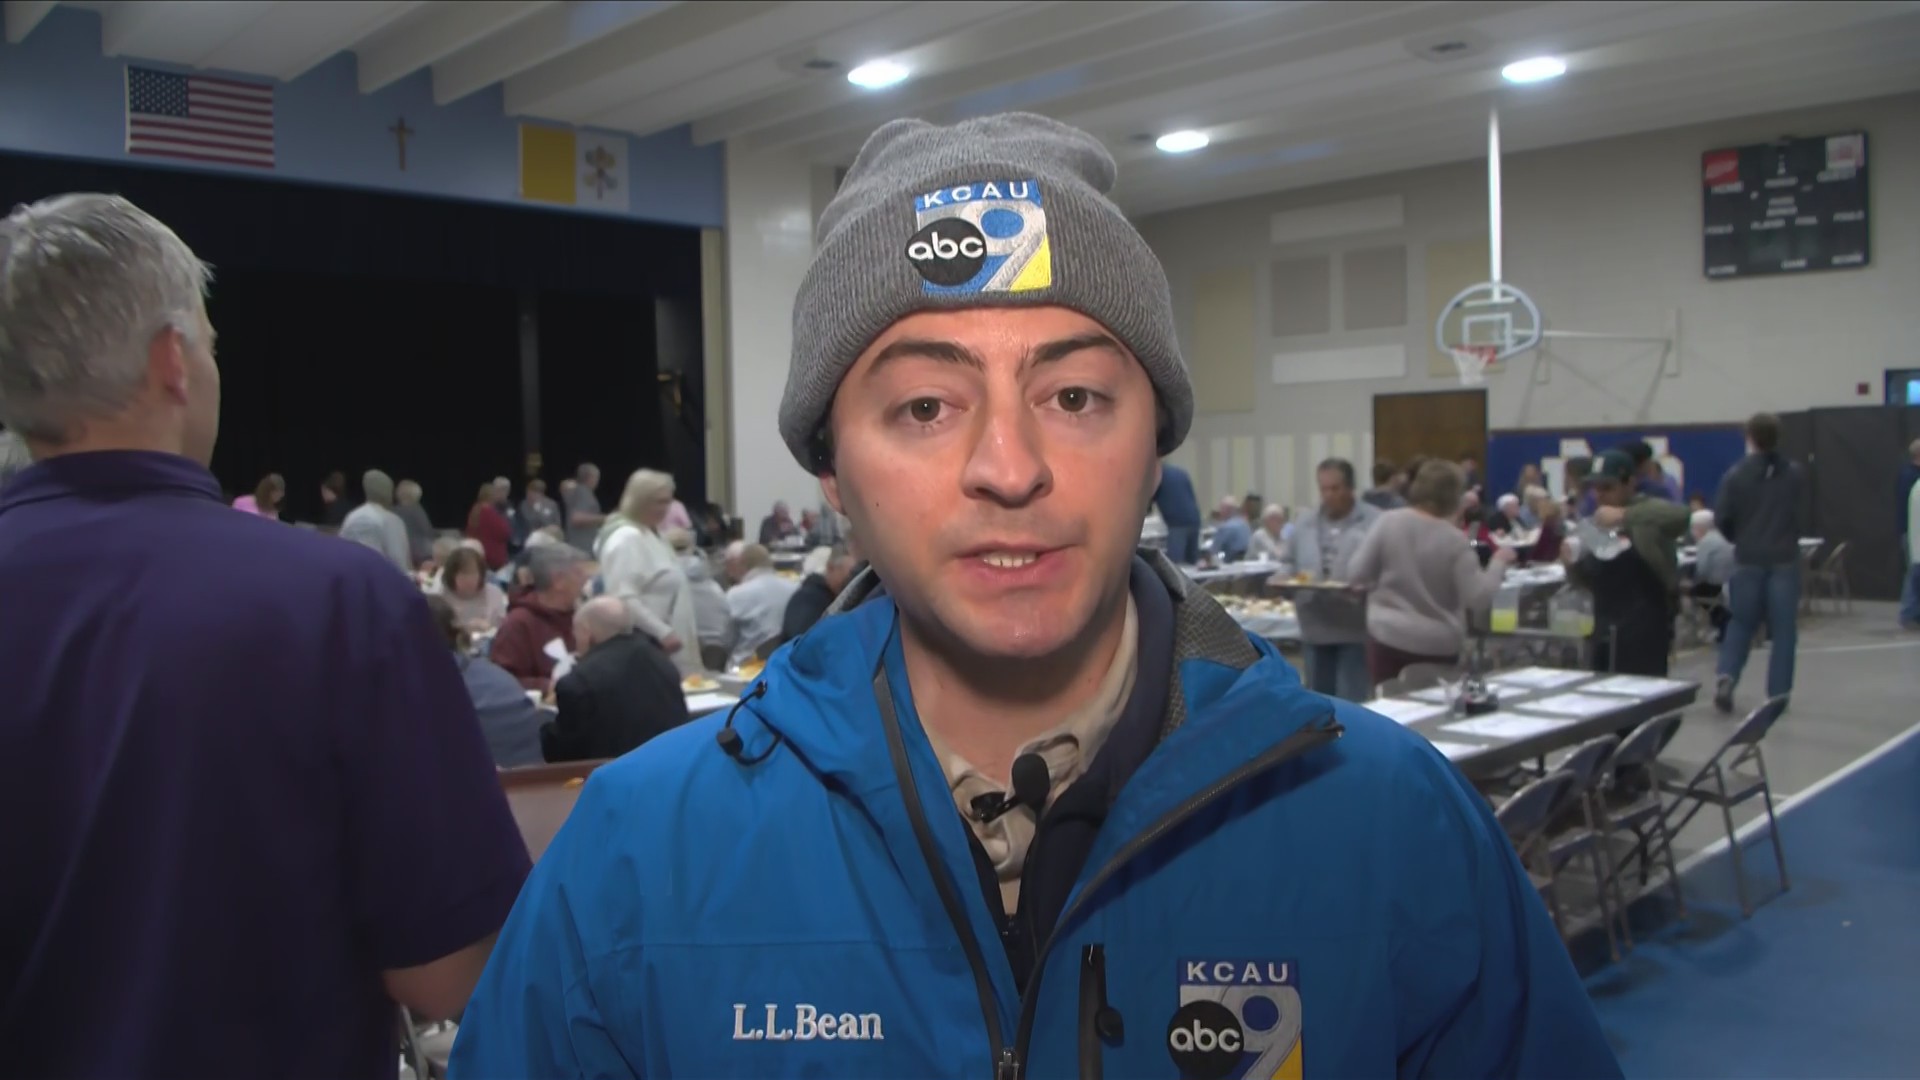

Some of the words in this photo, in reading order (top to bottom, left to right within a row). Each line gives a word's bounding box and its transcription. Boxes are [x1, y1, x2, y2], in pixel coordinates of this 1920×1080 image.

[924, 182, 1028, 208] KCAU
[908, 232, 984, 260] abc
[960, 200, 1047, 292] 9
[1187, 961, 1288, 982] KCAU
[733, 1003, 885, 1040] L.L.Bean
[1170, 1019, 1241, 1053] abc
[1221, 985, 1302, 1080] 9
